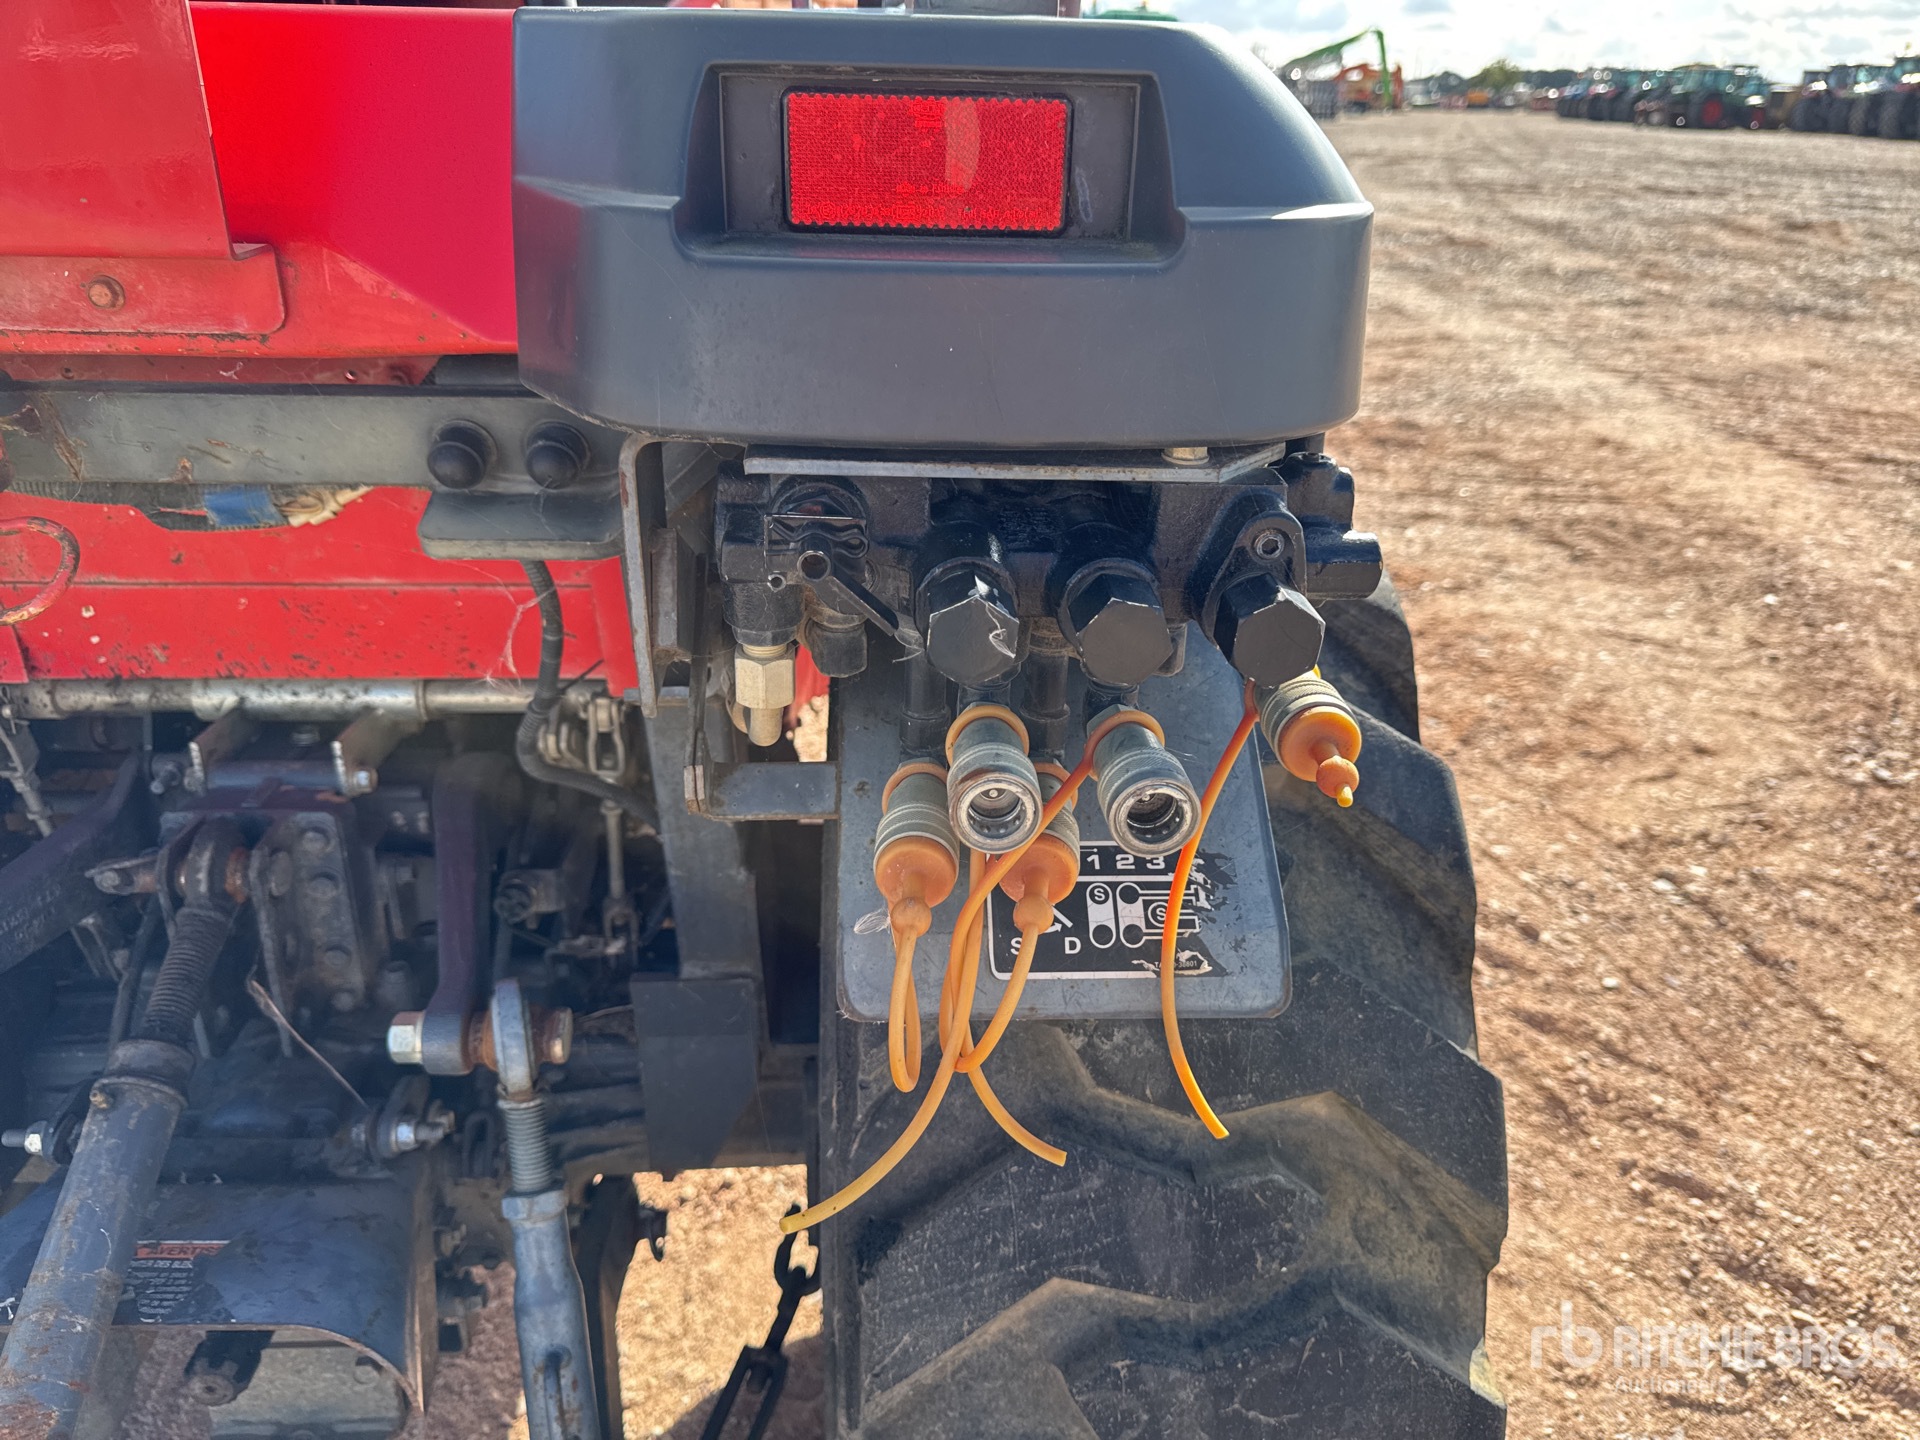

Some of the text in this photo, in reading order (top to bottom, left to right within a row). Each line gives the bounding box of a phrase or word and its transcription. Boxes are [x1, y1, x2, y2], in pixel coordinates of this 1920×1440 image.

[1086, 854, 1166, 870] 1 2 3
[1093, 887, 1106, 901] S
[1064, 936, 1081, 954] D
